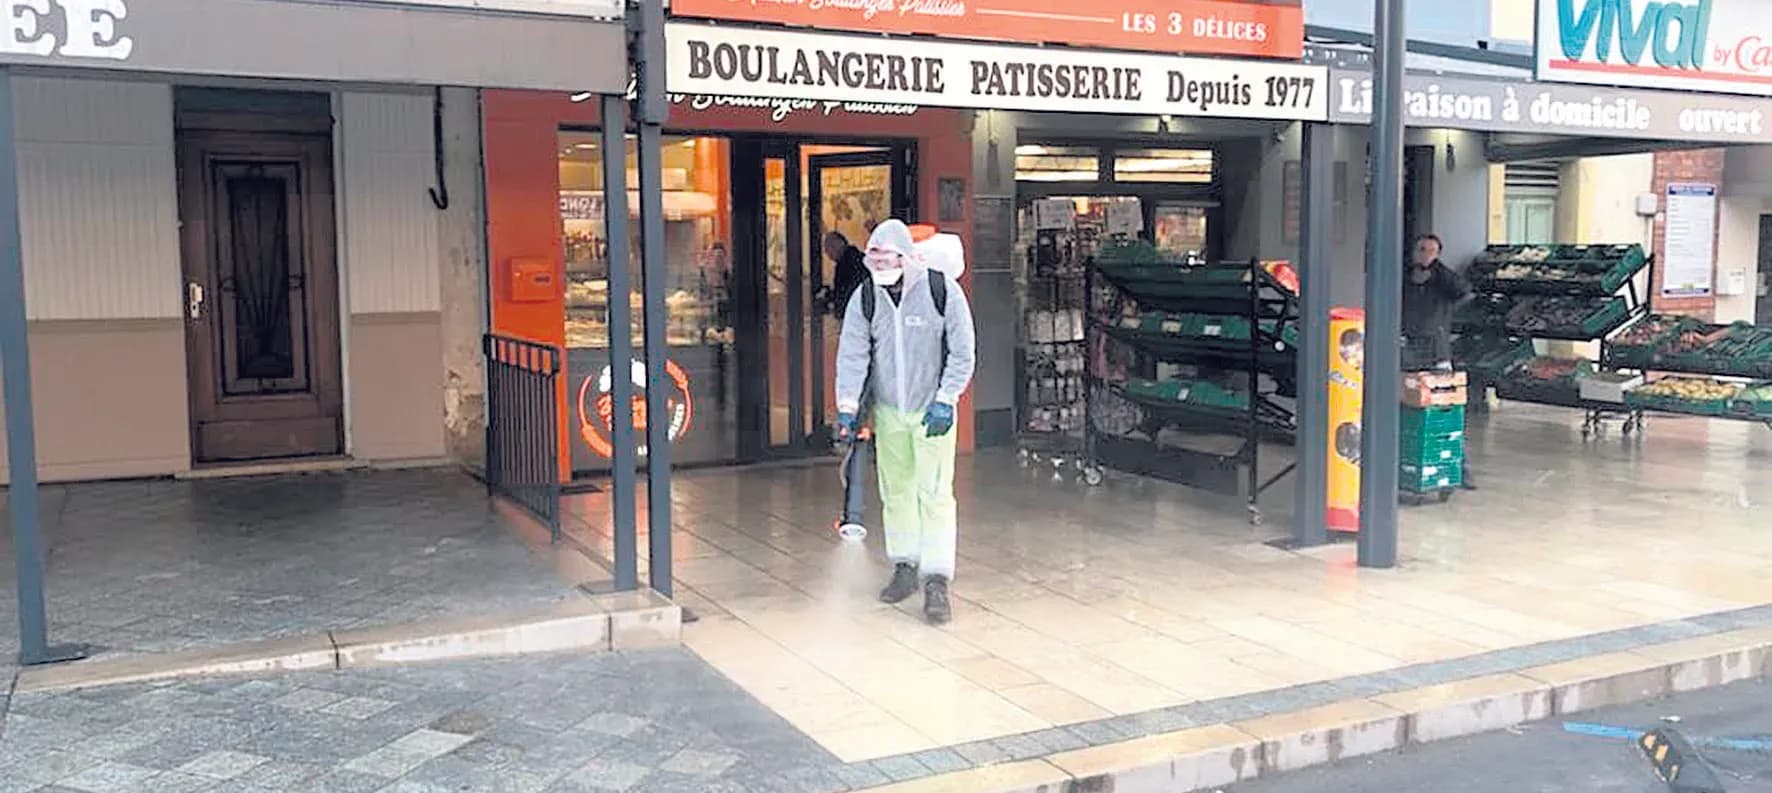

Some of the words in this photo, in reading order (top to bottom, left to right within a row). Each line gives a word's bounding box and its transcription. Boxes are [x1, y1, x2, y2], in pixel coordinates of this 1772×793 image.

[1122, 12, 1156, 33] LES
[1168, 12, 1182, 35] 3
[1193, 16, 1267, 41] DÉLICES
[1714, 43, 1731, 66] by
[1735, 35, 1772, 72] Ca
[687, 39, 945, 93] BOULANGERIE
[970, 60, 1142, 101] PATISSERIE
[1166, 70, 1252, 111] Depuis
[1264, 75, 1315, 108] 1977
[1501, 86, 1520, 122] à
[1530, 93, 1650, 131] domicile
[1679, 107, 1763, 134] ouvert
